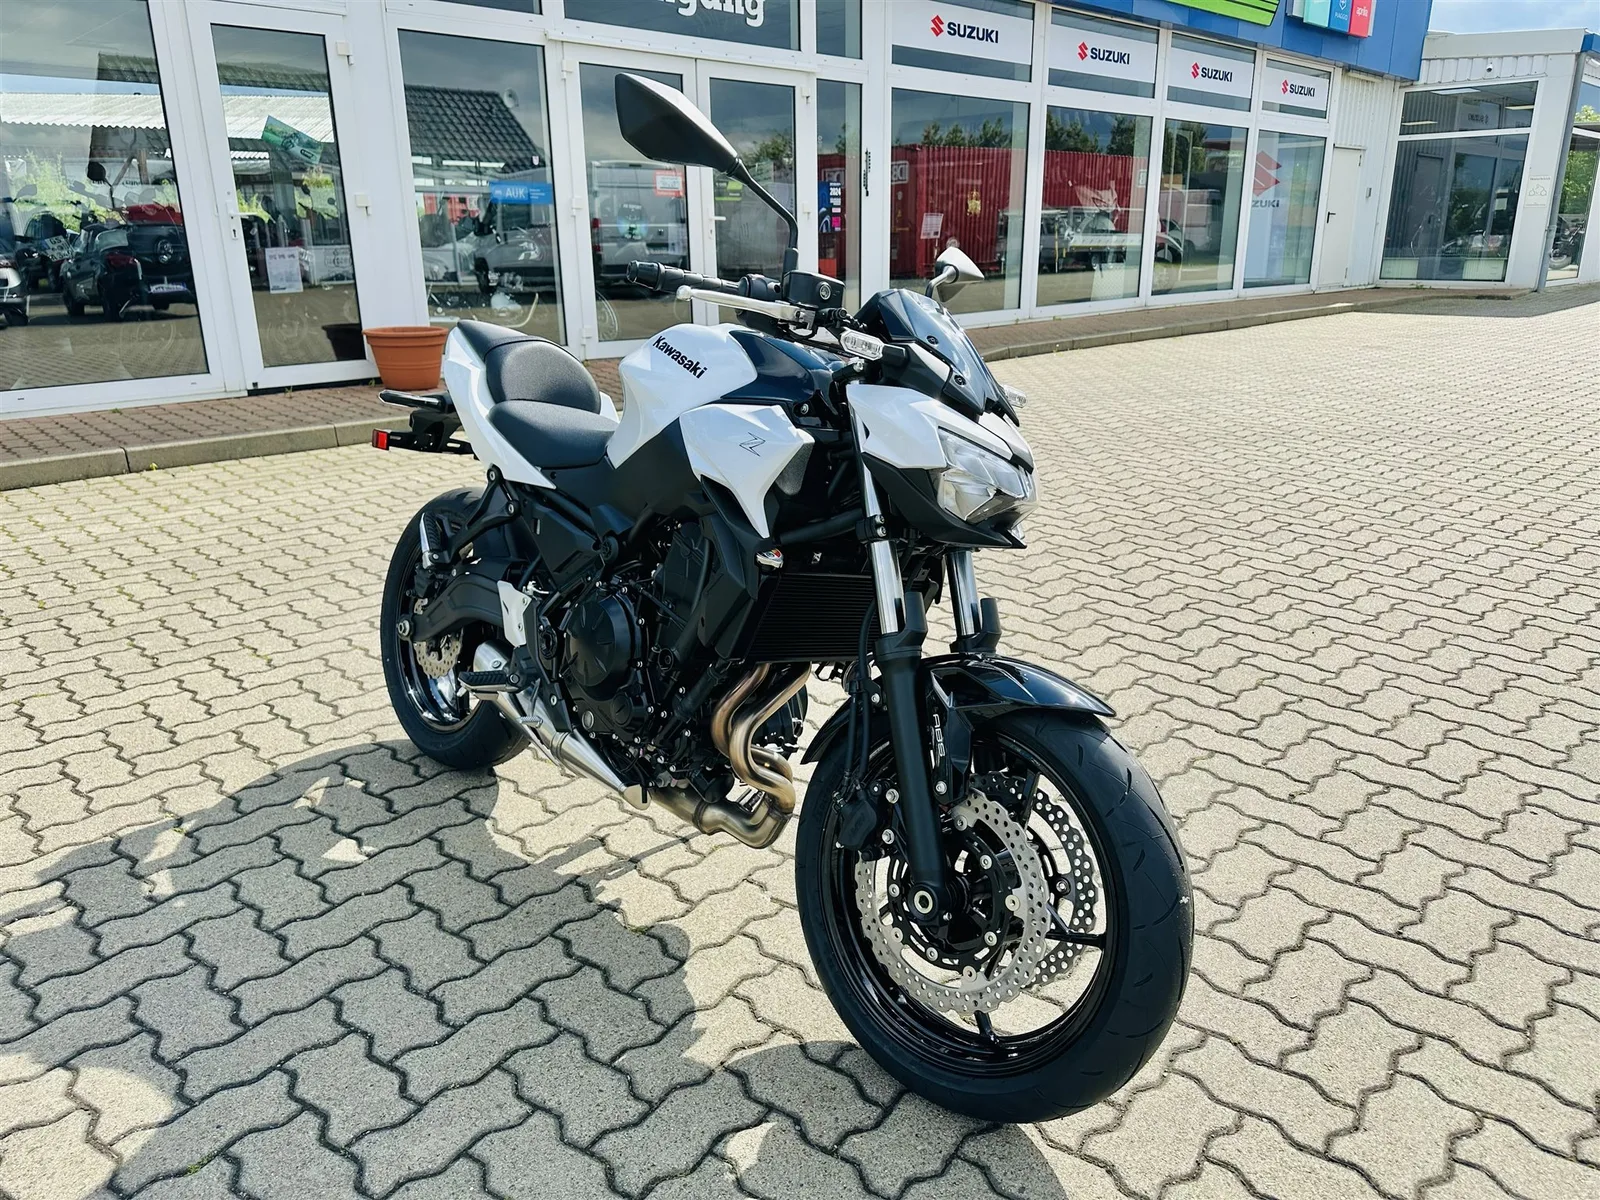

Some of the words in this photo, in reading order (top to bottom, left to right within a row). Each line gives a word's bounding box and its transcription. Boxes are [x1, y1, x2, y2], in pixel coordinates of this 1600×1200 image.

[946, 21, 999, 44] SUZUKI
[1090, 46, 1130, 65] SUZUKI
[1200, 66, 1233, 82] SUZUKI
[1289, 83, 1316, 97] SUZUKI
[505, 187, 526, 199] AUK
[829, 187, 842, 196] 2024
[1251, 199, 1280, 208] ZUKI
[652, 335, 708, 379] Kawasaki
[932, 713, 946, 757] ABS
